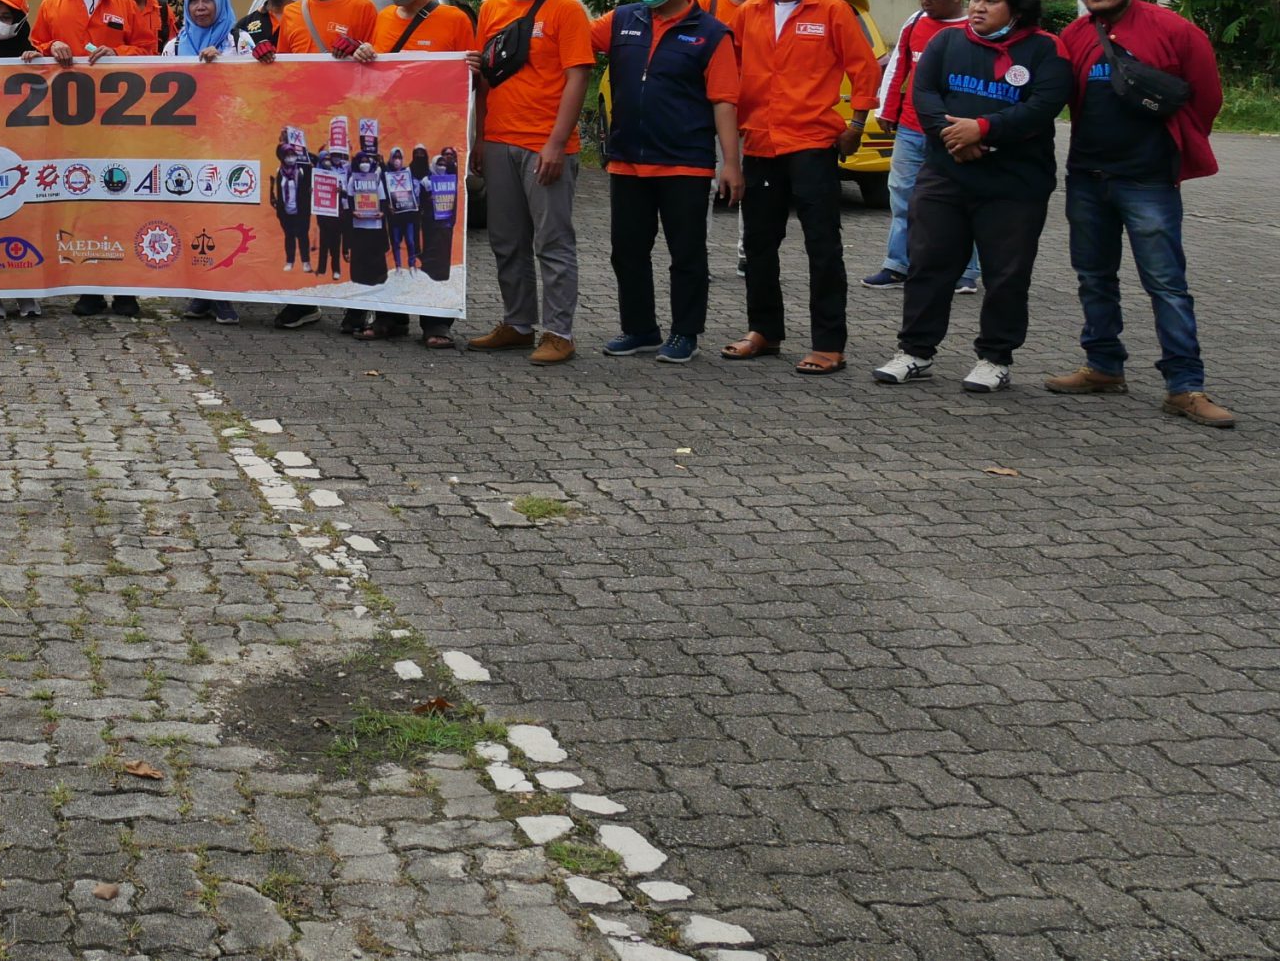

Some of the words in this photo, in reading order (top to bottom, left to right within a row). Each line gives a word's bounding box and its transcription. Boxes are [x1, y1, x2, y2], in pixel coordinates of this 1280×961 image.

[948, 73, 984, 92] GARDA
[4, 71, 197, 129] 2022
[354, 180, 377, 191] LAWAN
[433, 181, 456, 192] LAWAN
